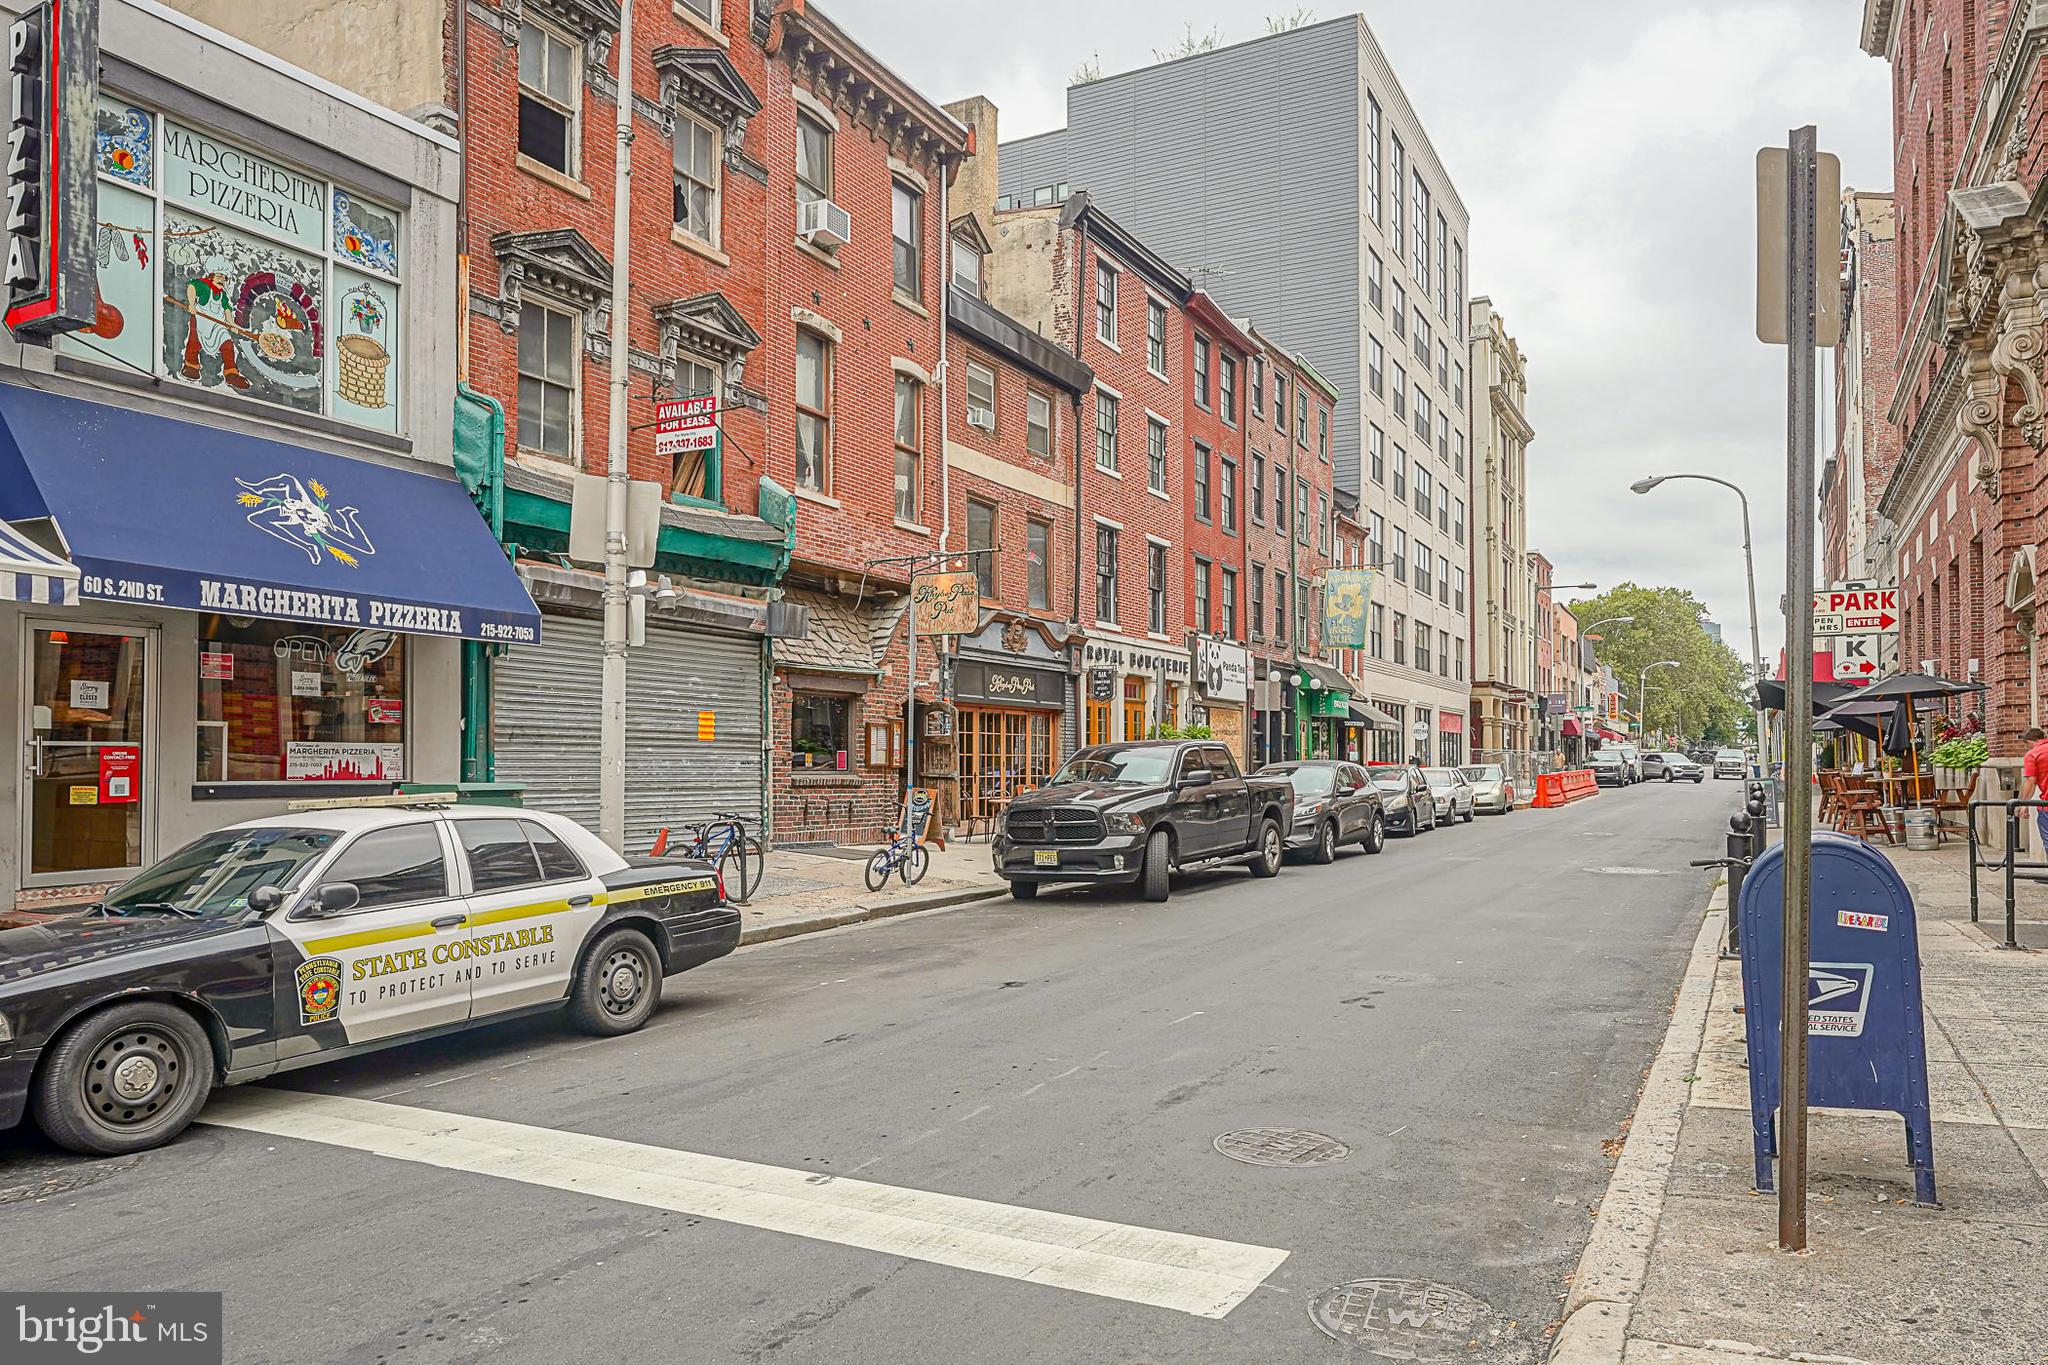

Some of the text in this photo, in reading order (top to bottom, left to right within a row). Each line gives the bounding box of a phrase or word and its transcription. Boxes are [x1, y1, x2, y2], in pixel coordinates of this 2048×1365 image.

[4, 20, 40, 290] PIZZA
[164, 127, 323, 212] MARGHERITA
[188, 170, 299, 234] PIZZERIA
[658, 399, 713, 419] AVAILABLE
[661, 414, 711, 431] FOR LEASE
[83, 575, 165, 602] 60 S. 2ND ST.
[200, 580, 463, 634] MARGHERITA PIZZERIA
[930, 600, 955, 620] Pub
[1830, 591, 1897, 612] PARK
[480, 622, 534, 641] 215-922-7053
[1847, 618, 1881, 627] ENTER
[273, 638, 329, 663] OPEN
[1086, 645, 1125, 666] ROYAL
[1222, 661, 1237, 673] Panda
[80, 682, 98, 694] Sorry
[341, 748, 376, 756] PIZZERIA
[643, 880, 712, 896] EMERGENCY 911
[352, 924, 554, 982] STATE CONSTABLE
[299, 959, 339, 975] PENNSYLVANIA
[299, 966, 341, 982] STATE CONSTABLE
[350, 950, 556, 1006] TO PROTECT AND TO SERVE
[309, 1013, 330, 1023] POLICE
[1822, 1015, 1854, 1024] STATES
[1820, 1024, 1857, 1033] SERVICE
